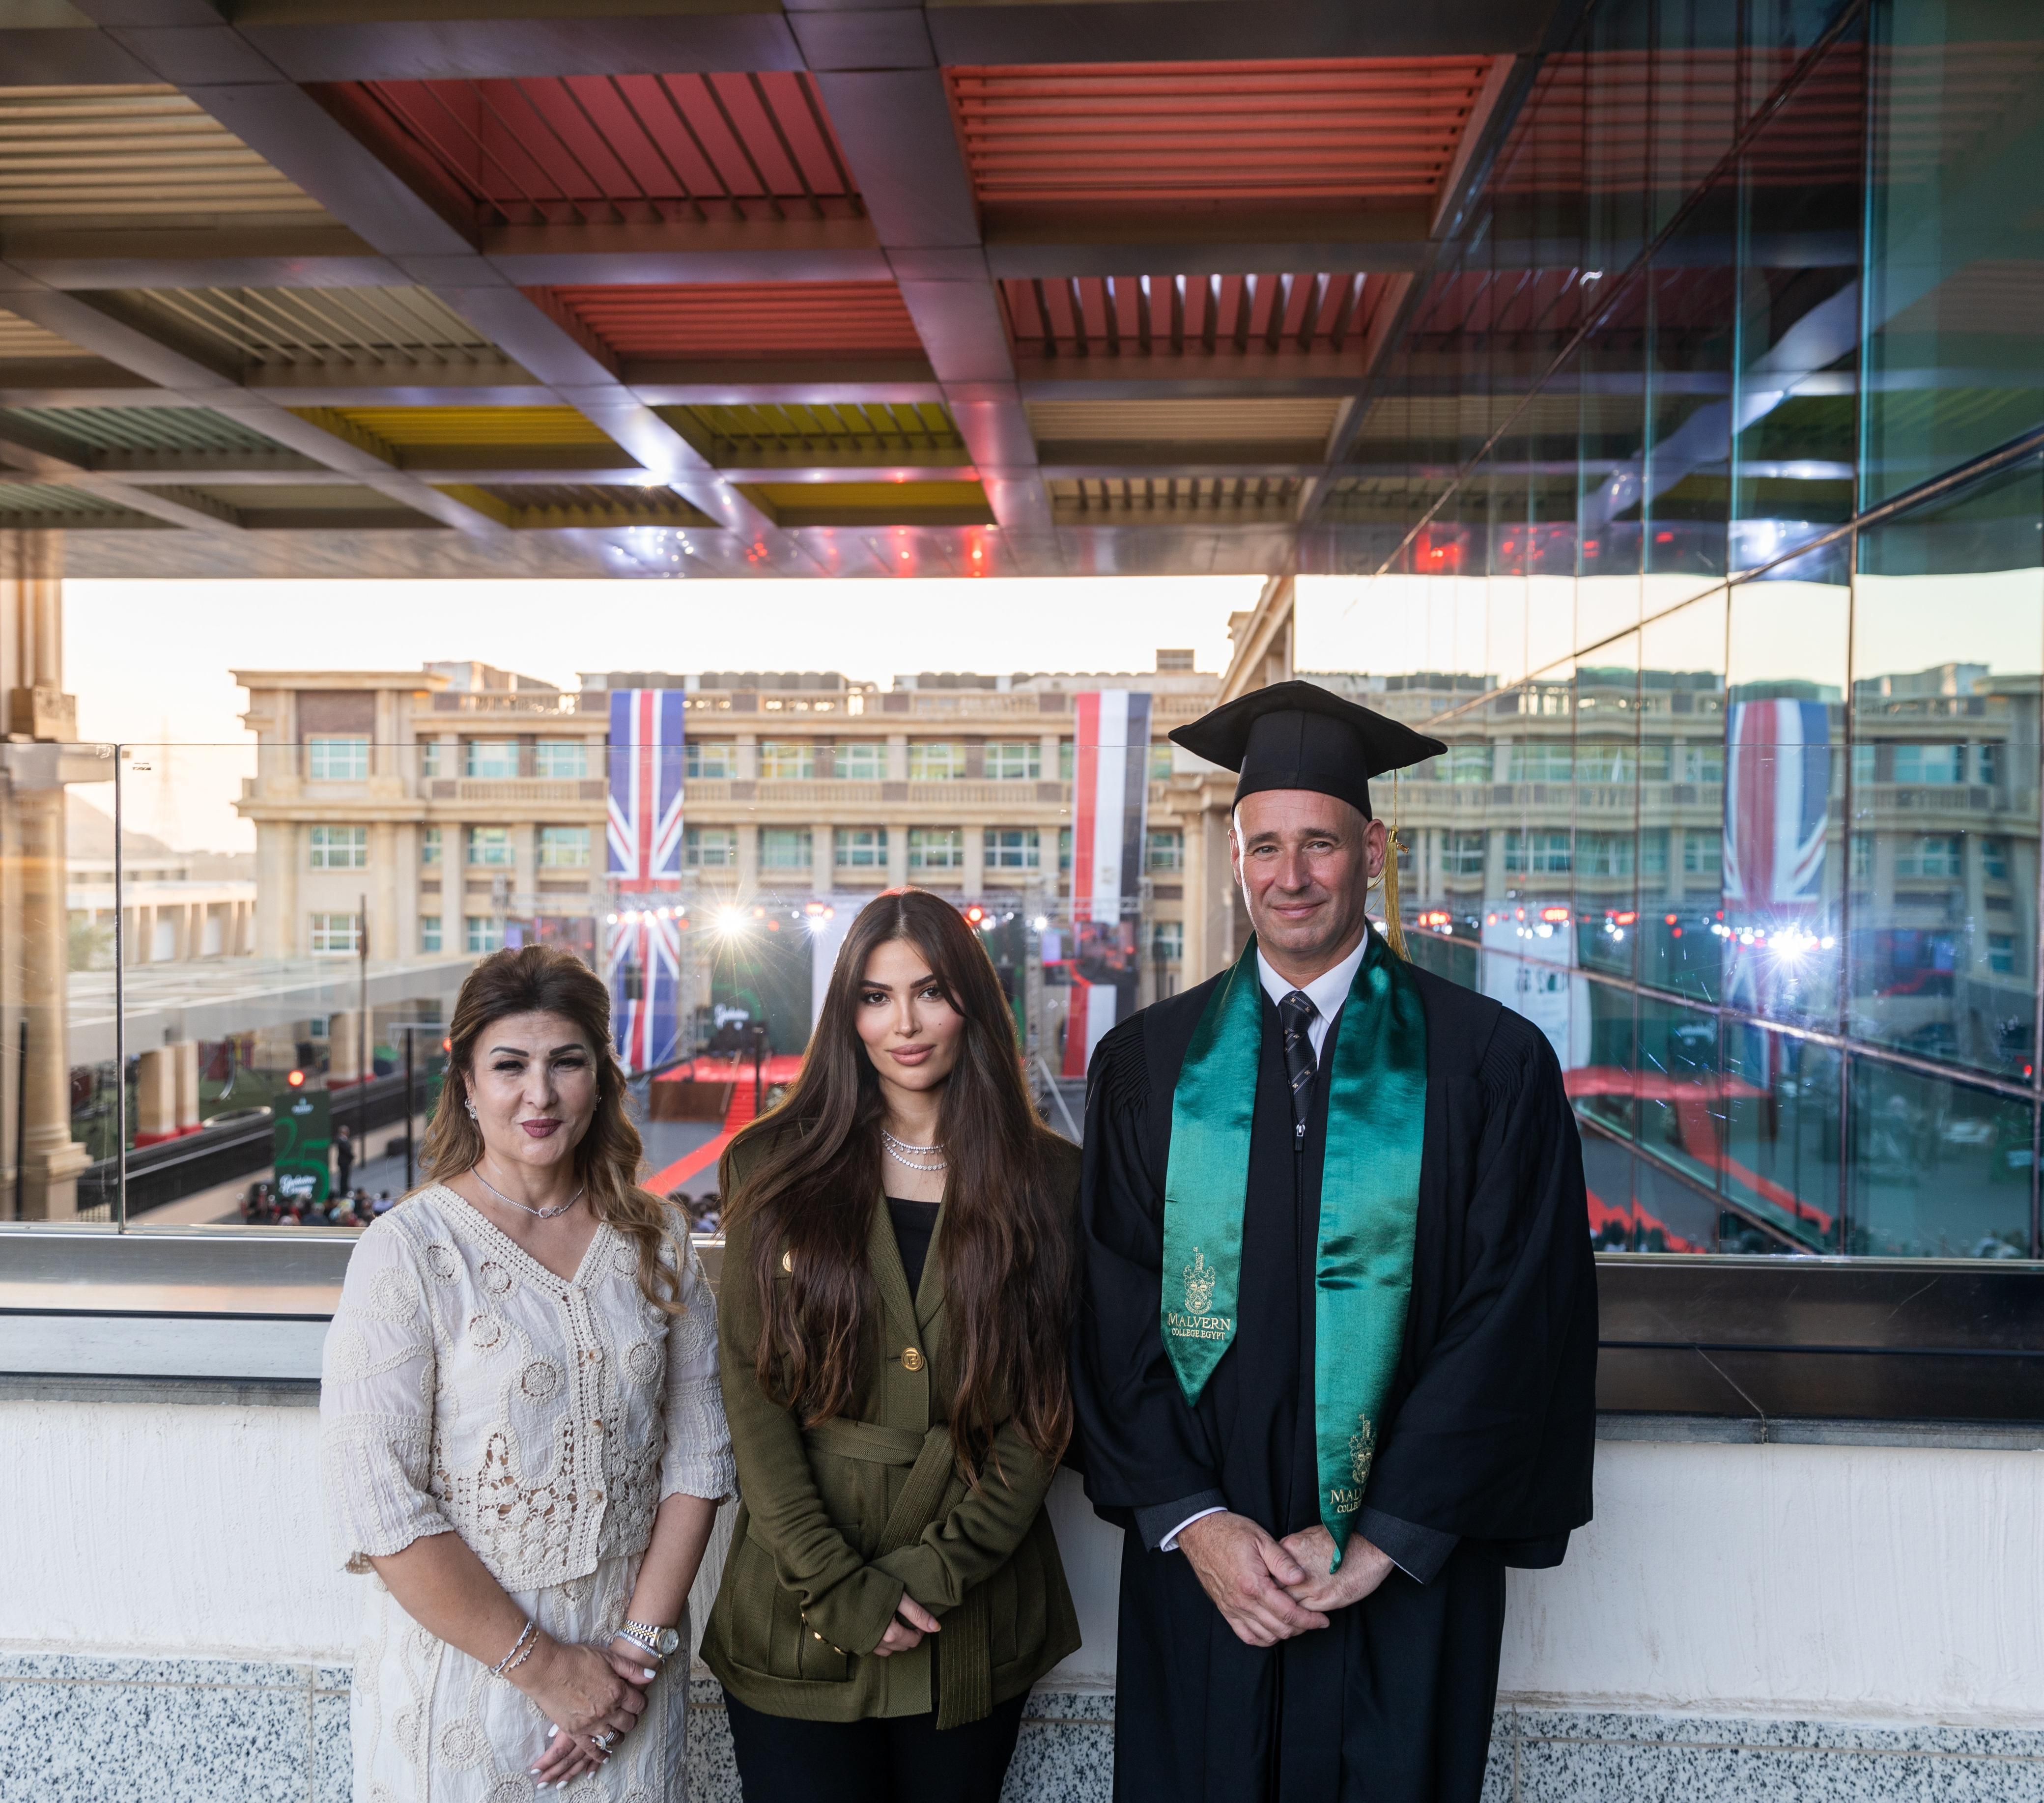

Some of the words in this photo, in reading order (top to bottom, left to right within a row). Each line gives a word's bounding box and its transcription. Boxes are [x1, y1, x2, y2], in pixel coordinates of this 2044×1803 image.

[1168, 1312, 1231, 1331] MALVERN
[1172, 1327, 1199, 1337] COLLEGE
[1201, 1329, 1225, 1340] EGYPT
[1330, 1486, 1365, 1504] MALV
